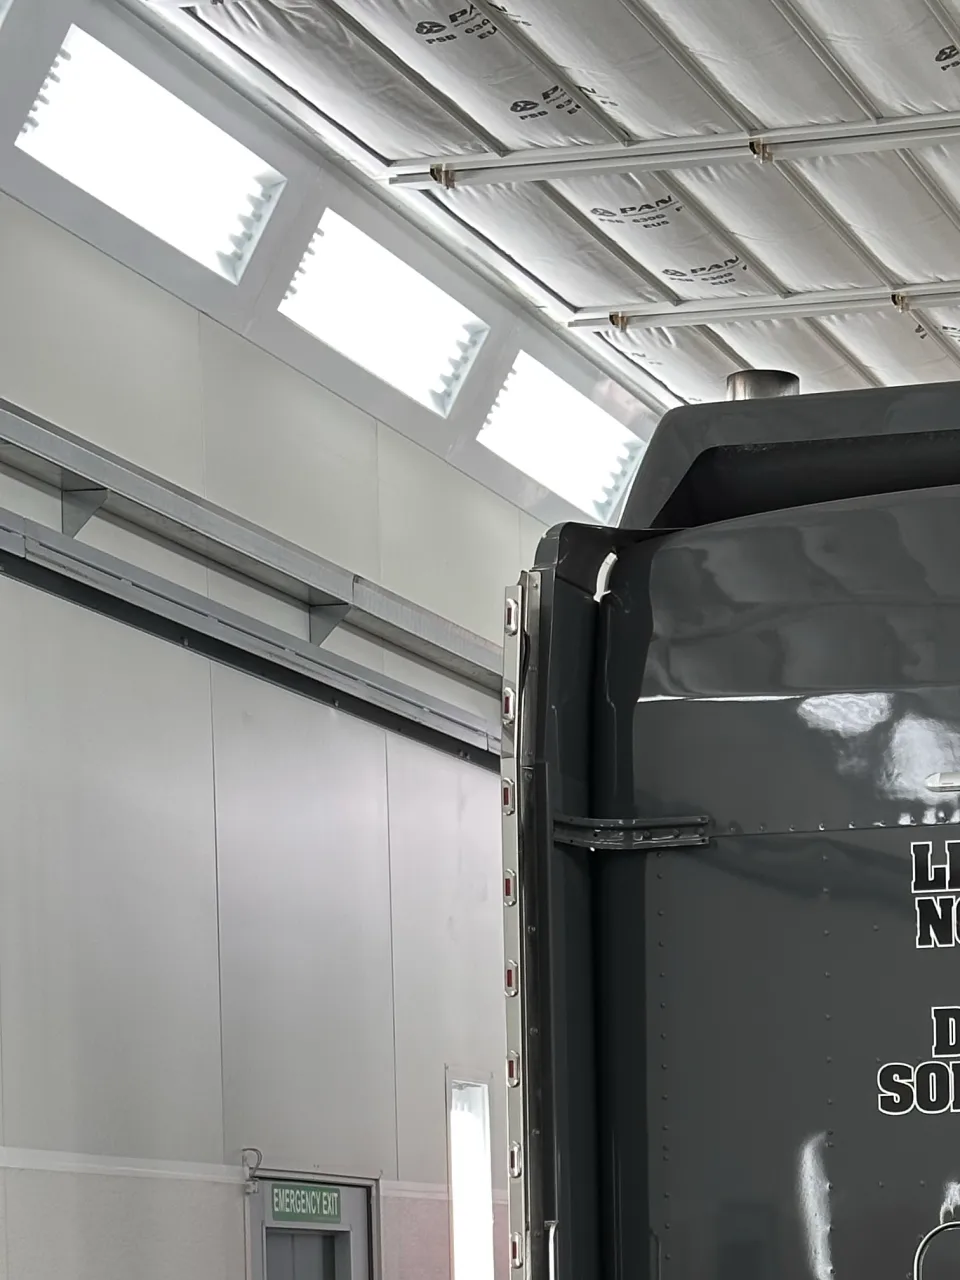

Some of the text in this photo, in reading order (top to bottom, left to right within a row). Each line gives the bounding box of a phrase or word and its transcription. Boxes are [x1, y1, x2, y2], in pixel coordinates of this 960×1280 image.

[618, 194, 673, 215] PAN
[689, 254, 740, 275] PAN
[273, 1187, 339, 1215] EMERGENCY EXIT
